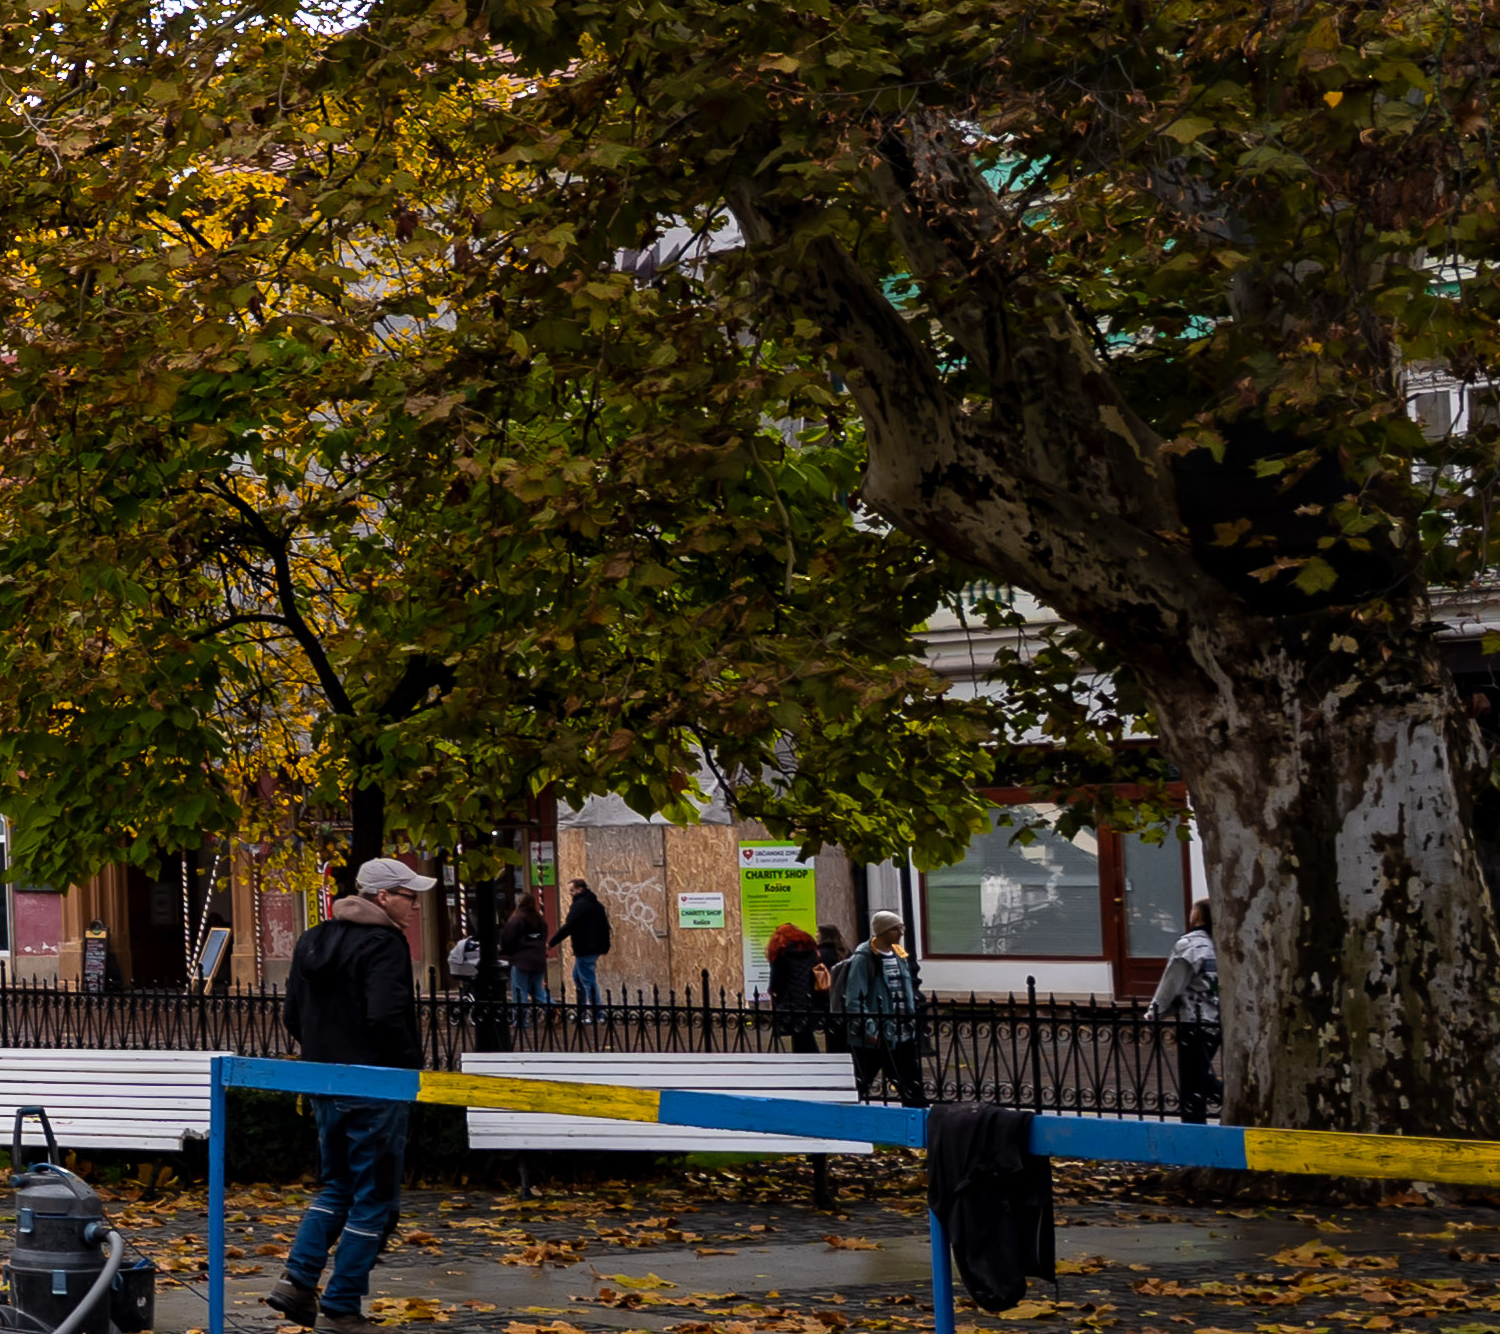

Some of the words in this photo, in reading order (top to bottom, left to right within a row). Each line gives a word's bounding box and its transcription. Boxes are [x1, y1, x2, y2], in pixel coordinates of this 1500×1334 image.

[745, 870, 783, 879] CHARITY
[785, 870, 808, 879] SHOP
[764, 883, 791, 892] Košice
